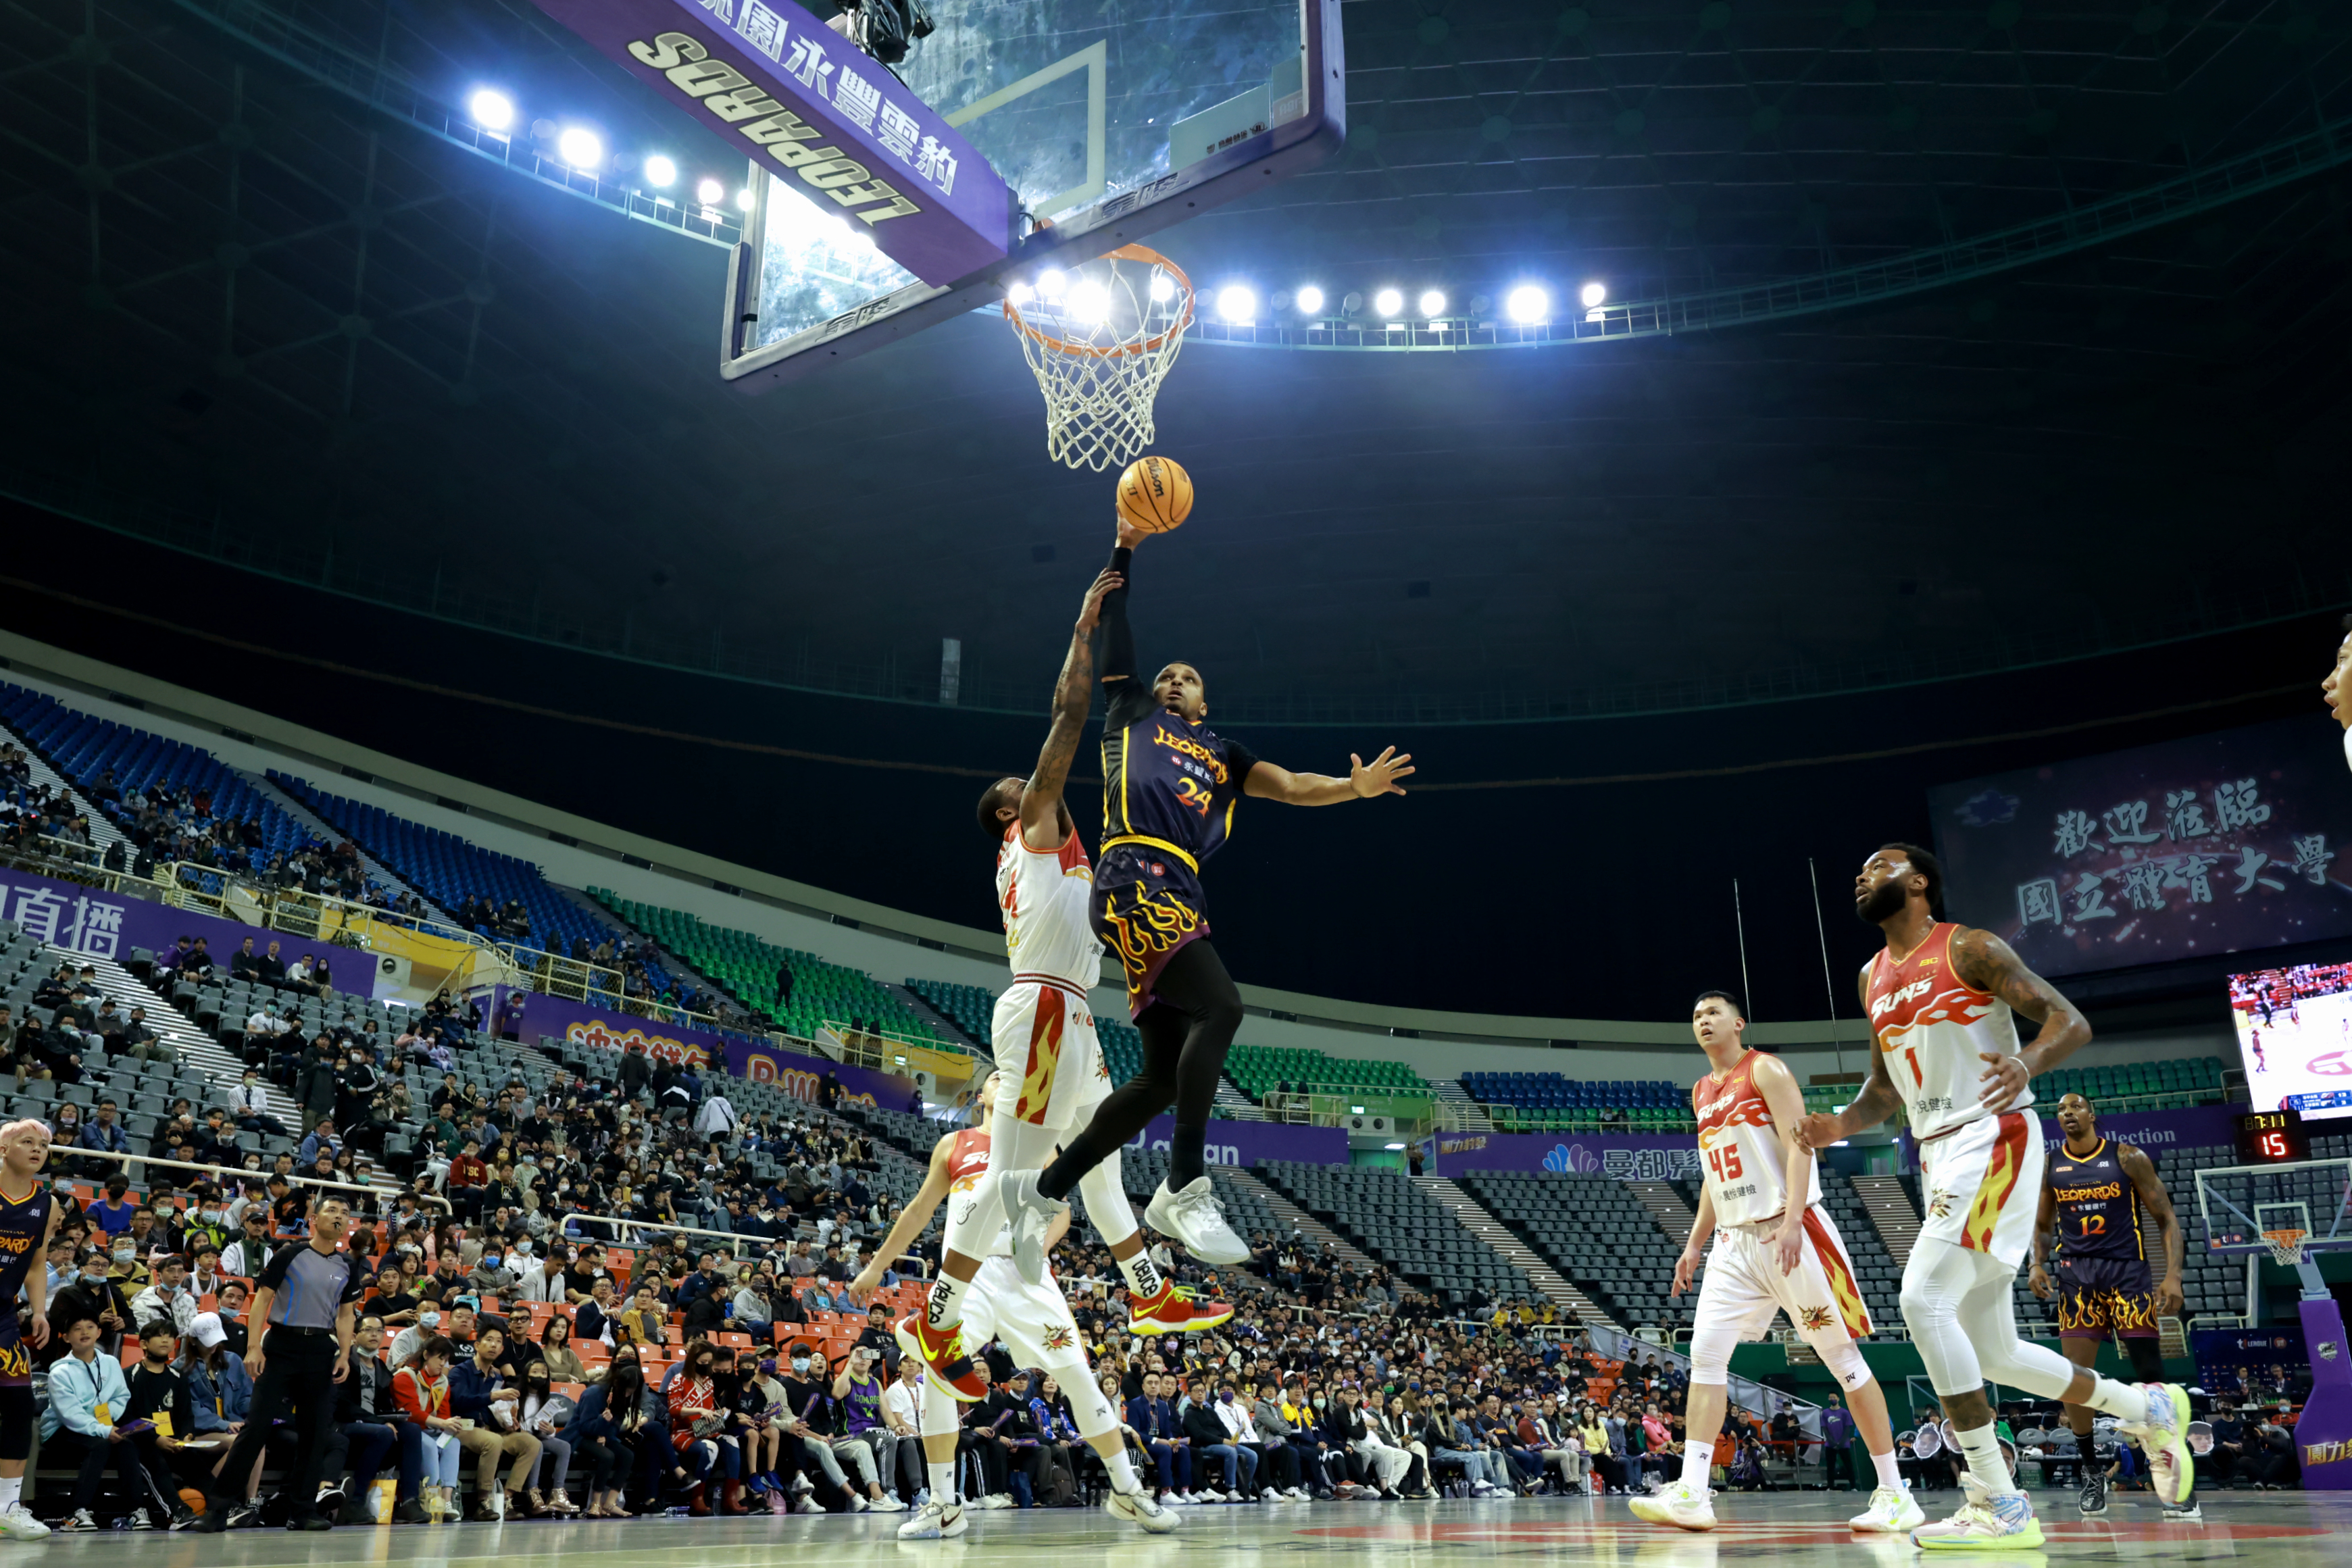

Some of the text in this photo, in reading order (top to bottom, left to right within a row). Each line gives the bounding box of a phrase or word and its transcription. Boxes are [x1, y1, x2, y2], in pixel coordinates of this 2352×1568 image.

[628, 32, 921, 226] LEOPARDS
[1176, 778, 1213, 819] 24
[2054, 778, 2270, 858] 歡迎蒞臨
[2017, 834, 2334, 926] 國立體育大學
[0, 884, 125, 958] 直播
[1871, 975, 1938, 1025] SUNS
[1905, 1047, 1923, 1090] 1
[1698, 1090, 1738, 1126] SUNS
[2255, 1114, 2285, 1129] 7:11
[2097, 1128, 2176, 1145] llection
[2263, 1134, 2286, 1155] 15
[1708, 1142, 1743, 1182] 45
[2053, 1182, 2122, 1203] LEOPARDS
[2079, 1214, 2107, 1236] 12
[0, 1255, 17, 1264] 銀行
[1132, 1259, 1158, 1297] deuce
[928, 1280, 955, 1323] deuce
